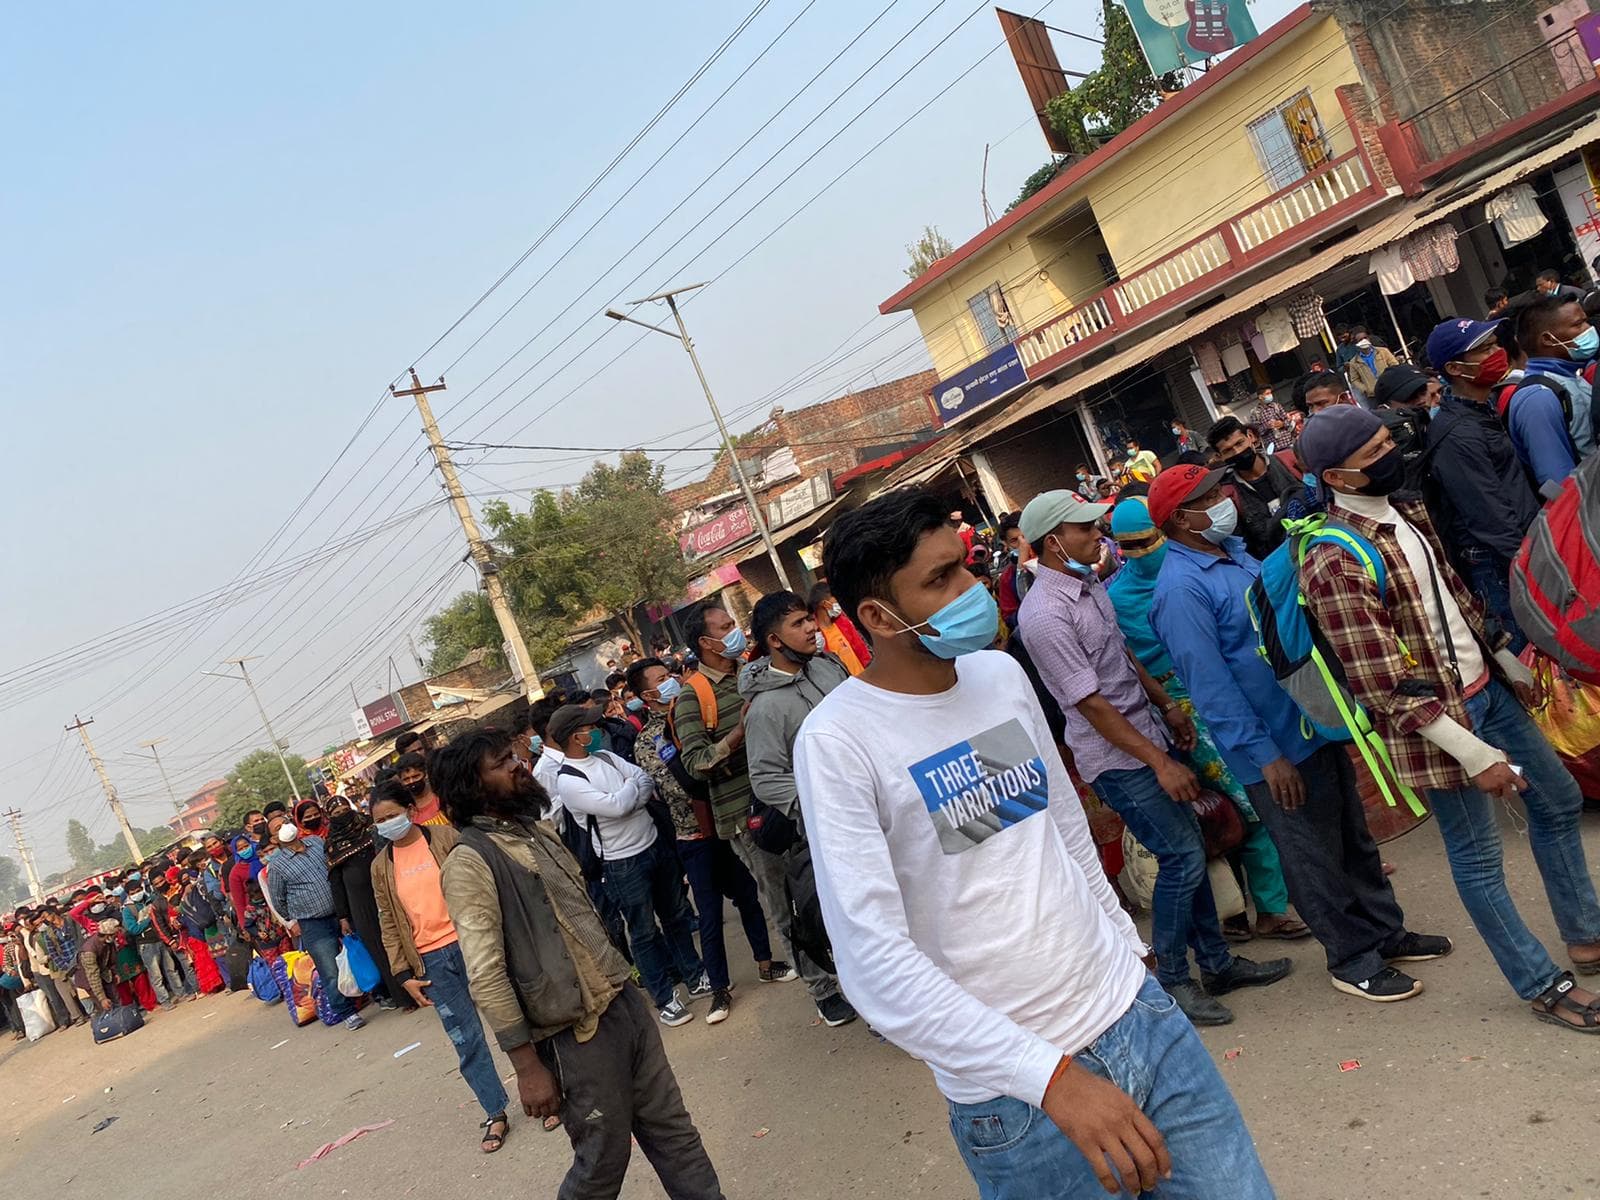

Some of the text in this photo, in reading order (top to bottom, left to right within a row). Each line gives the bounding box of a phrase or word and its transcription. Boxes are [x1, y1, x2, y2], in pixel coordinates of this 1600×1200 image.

[370, 714, 386, 727] ROYAL
[384, 708, 398, 721] STAG
[925, 750, 988, 799] THREE
[940, 758, 1041, 830] VARIATIONS
